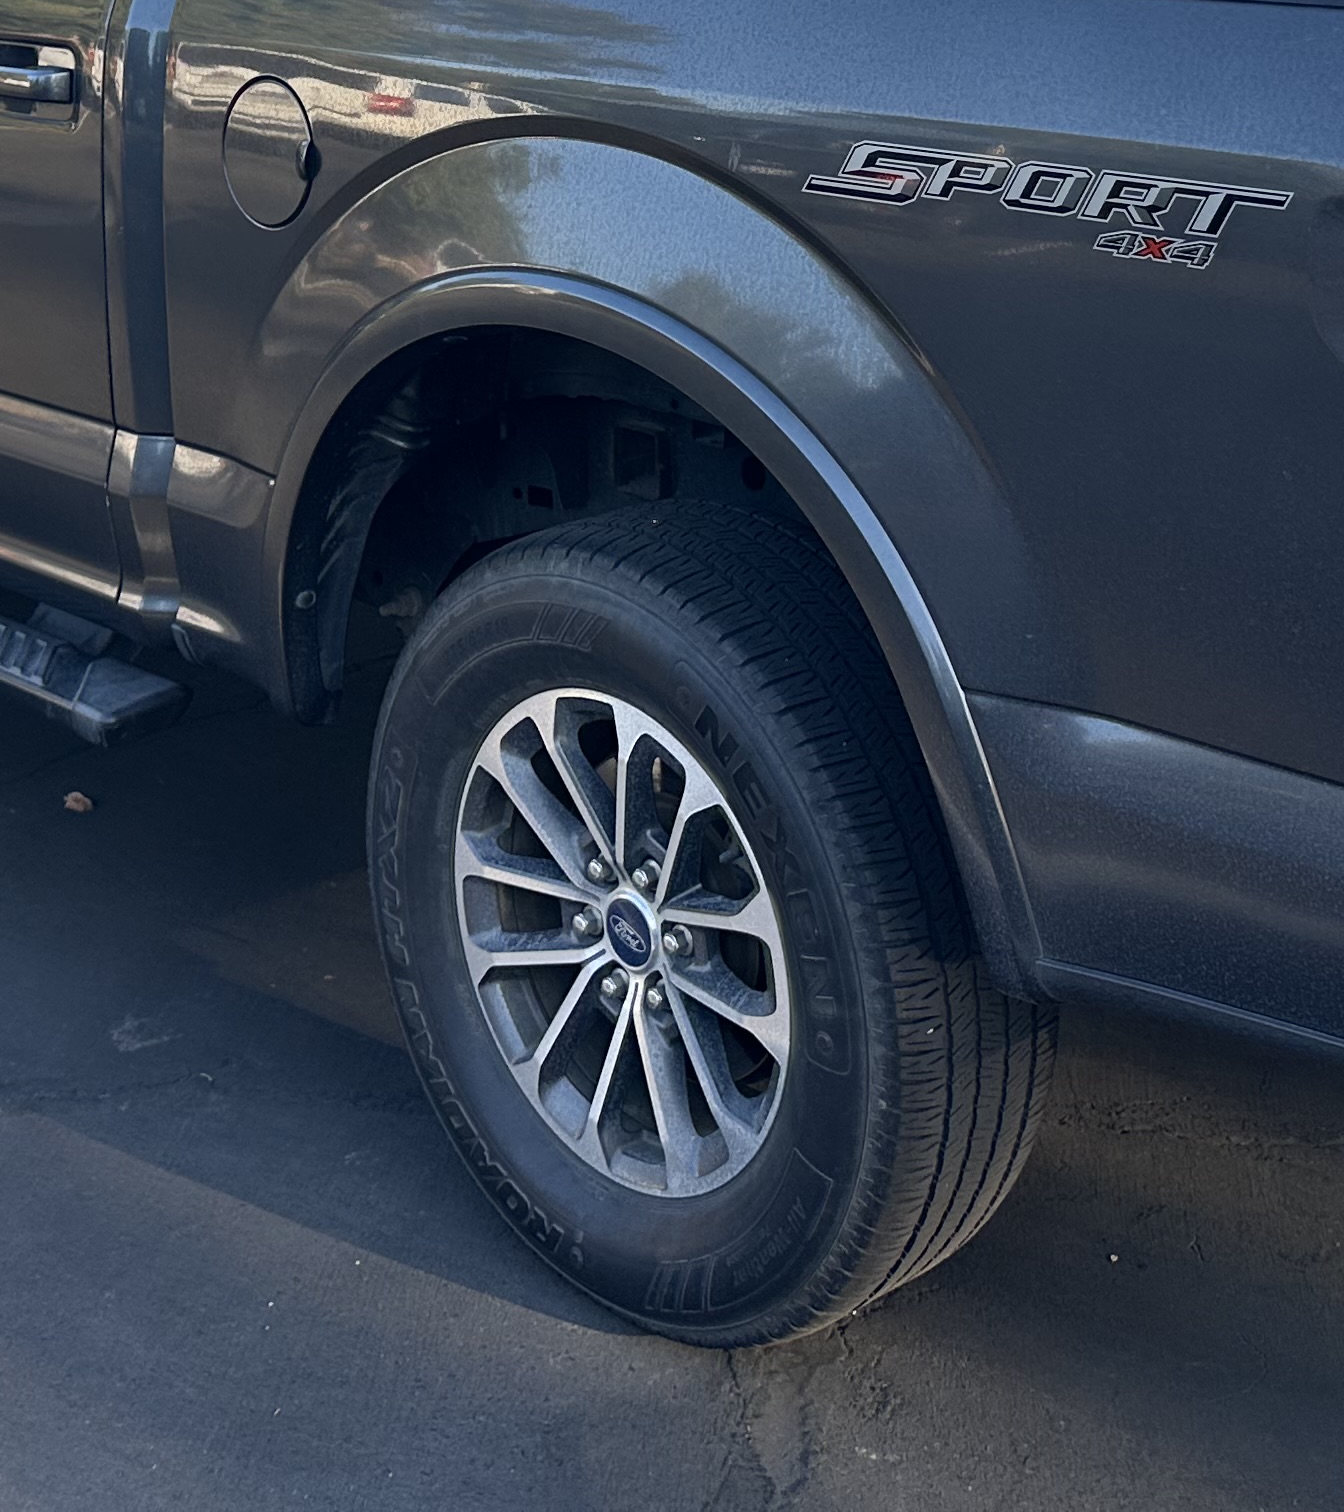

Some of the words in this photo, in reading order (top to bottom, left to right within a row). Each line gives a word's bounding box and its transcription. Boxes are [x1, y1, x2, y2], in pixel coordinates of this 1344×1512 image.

[802, 139, 1294, 238] SPORT
[614, 920, 640, 949] Ford
[692, 696, 838, 1024] NEXEN
[393, 973, 565, 1258] ROADIAN
